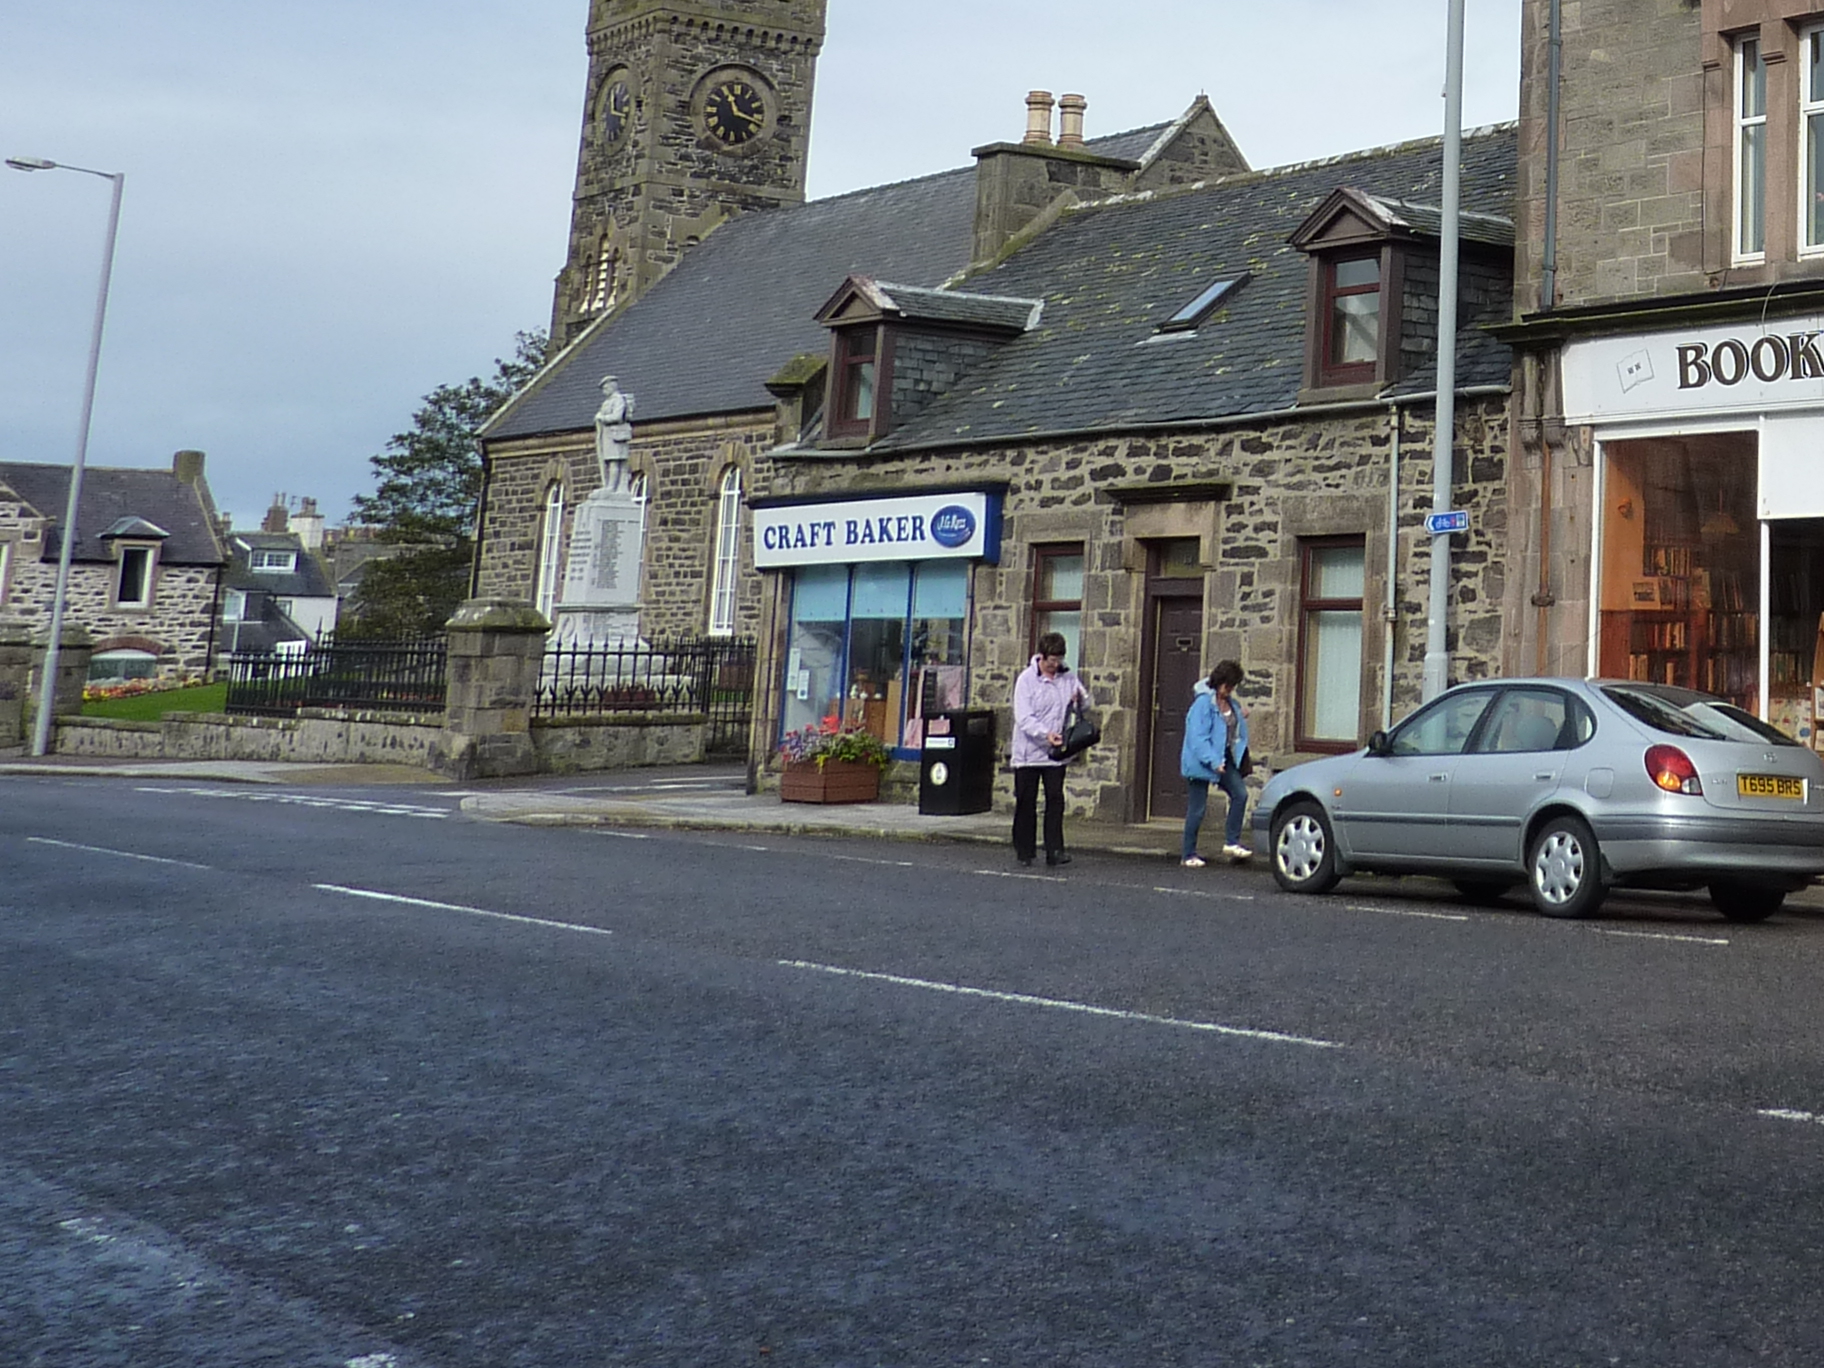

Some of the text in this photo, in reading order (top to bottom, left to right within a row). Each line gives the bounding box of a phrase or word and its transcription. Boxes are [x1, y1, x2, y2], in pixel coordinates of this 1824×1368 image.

[763, 515, 927, 550] CRAFT BAKER
[1740, 776, 1775, 793] T695
[1777, 778, 1802, 795] BRS
